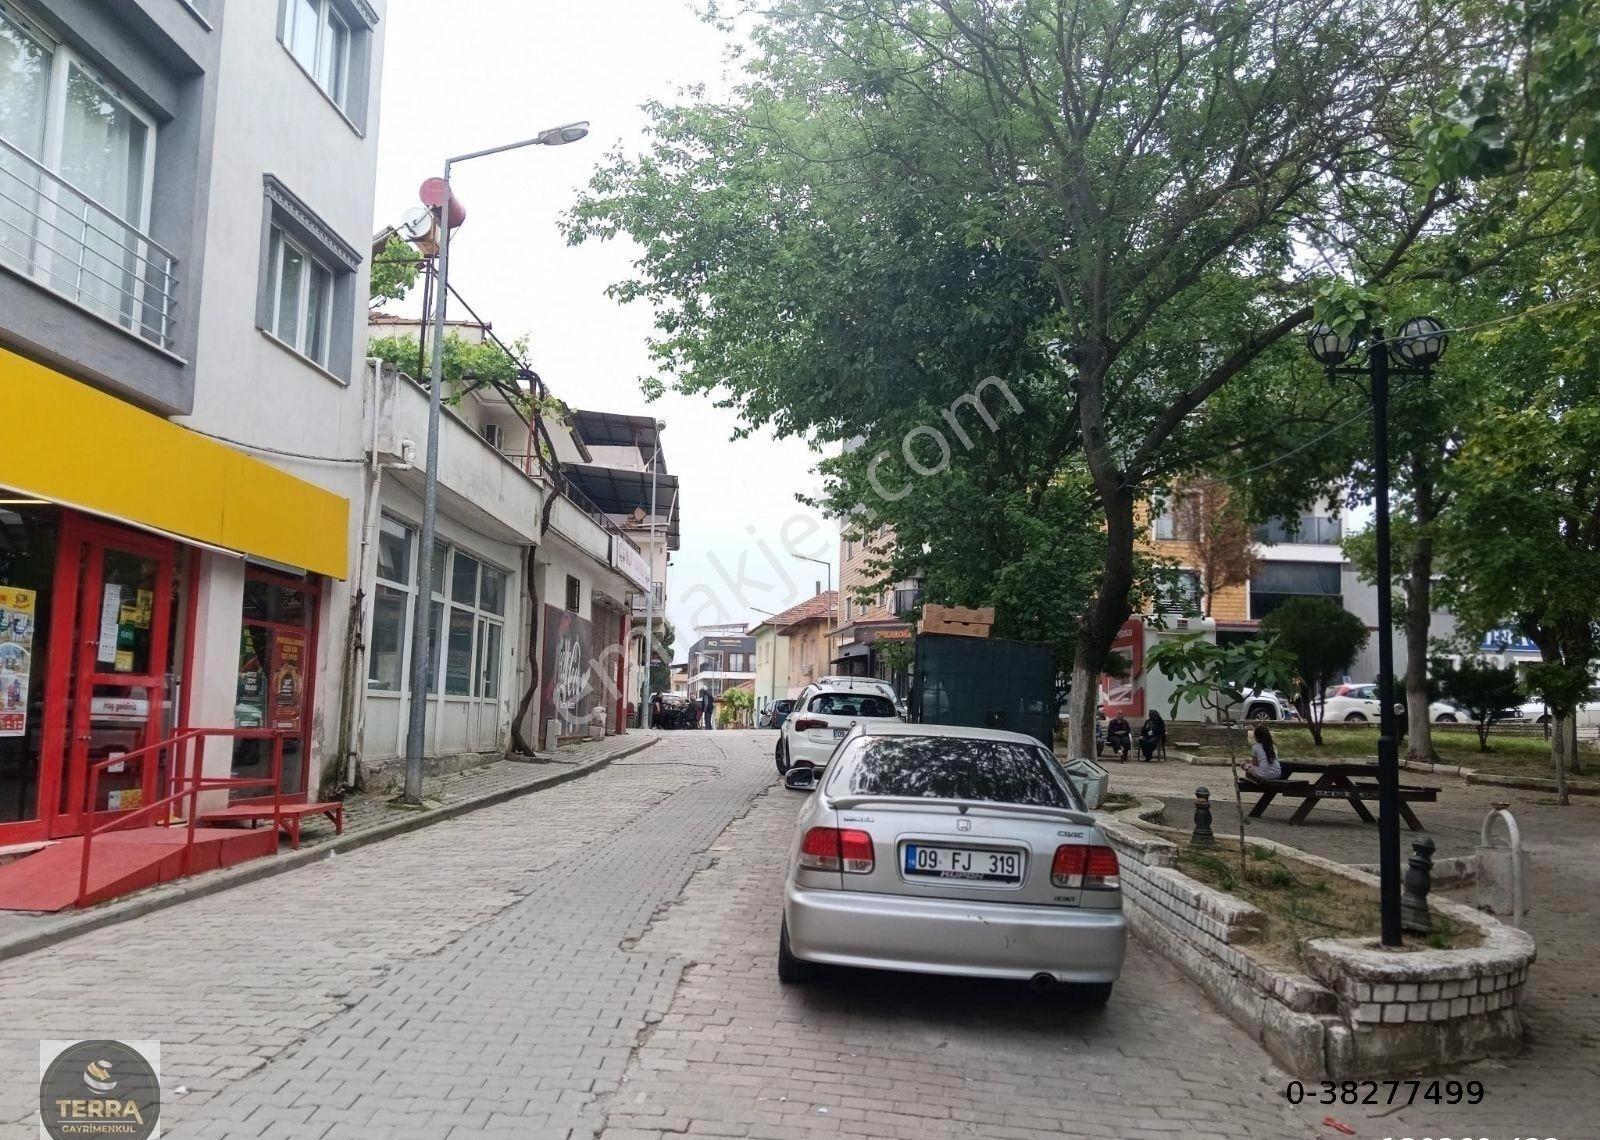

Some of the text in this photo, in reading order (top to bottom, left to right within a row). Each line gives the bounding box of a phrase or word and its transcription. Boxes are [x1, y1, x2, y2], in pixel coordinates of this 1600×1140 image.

[1057, 830, 1085, 838] CIVIC
[918, 849, 1015, 874] 09 FJ 319
